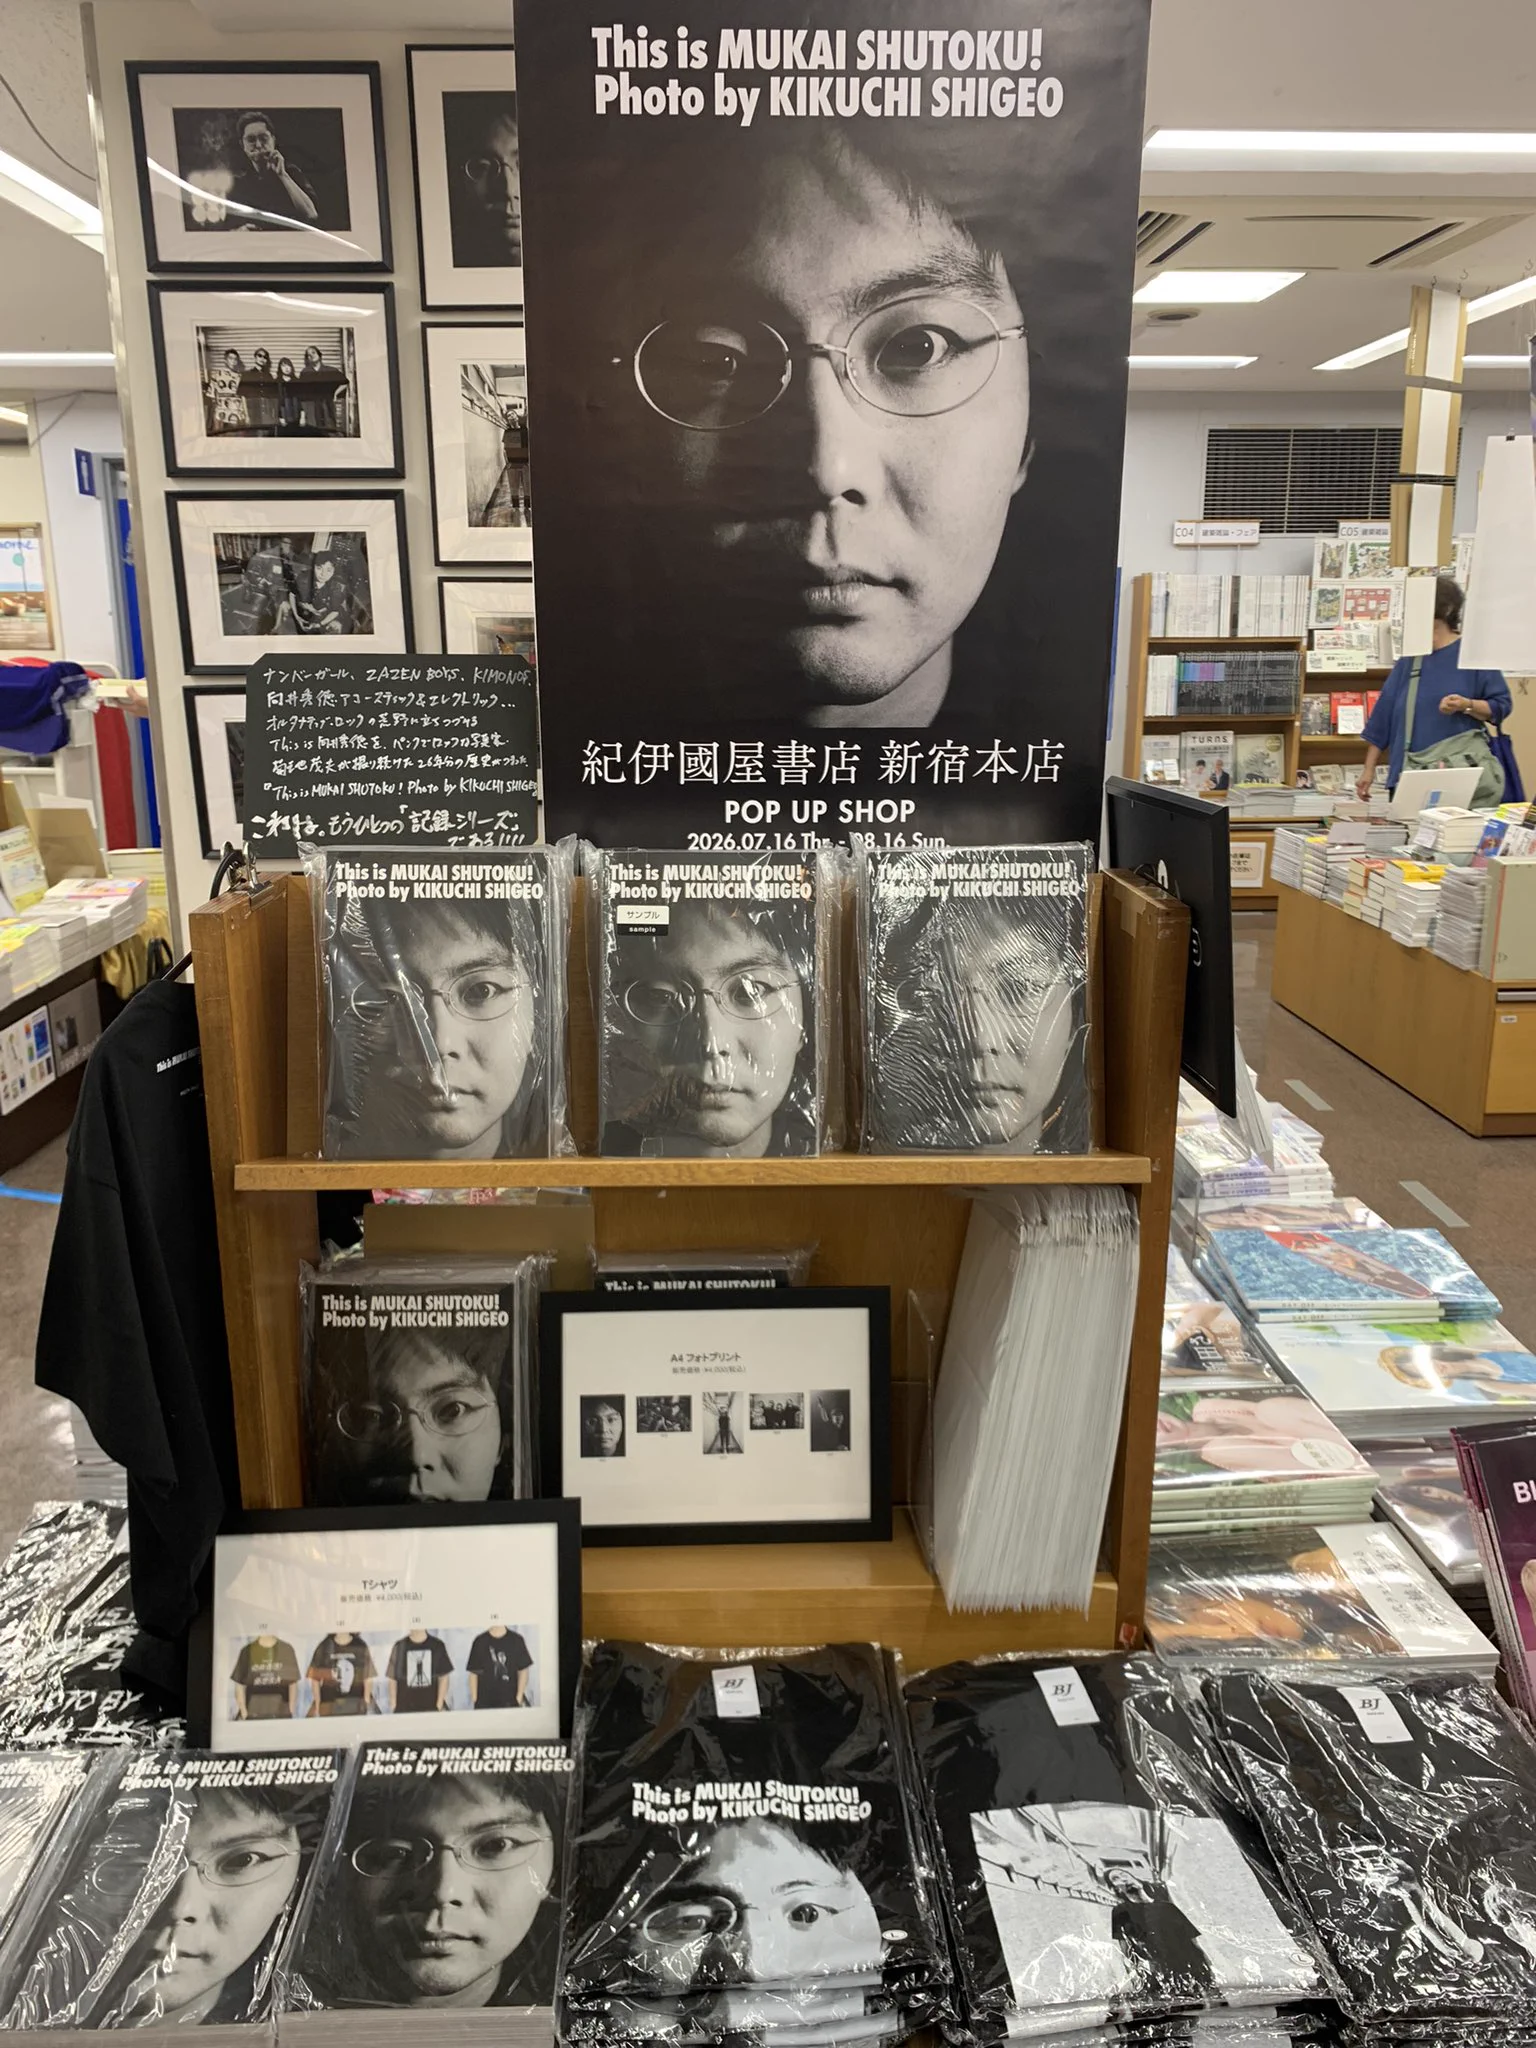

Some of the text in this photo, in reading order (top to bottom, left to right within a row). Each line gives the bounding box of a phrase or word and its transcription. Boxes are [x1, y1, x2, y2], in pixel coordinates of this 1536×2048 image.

[592, 25, 1042, 71] This is MUKAI SHUTOKU!
[595, 73, 1064, 127] Photo by KIKUCHI SHIGEO
[366, 666, 421, 682] ZAZEN
[269, 736, 300, 752] This
[303, 740, 314, 750] is
[581, 739, 1066, 786] 紀伊國屋書店 新宿本店
[299, 789, 310, 798] is
[311, 782, 345, 797] MUKAI
[407, 779, 440, 795] Photo
[443, 778, 457, 797] by
[459, 777, 504, 795] KIKUCHI
[724, 799, 916, 824] POP UP SHOP
[687, 832, 797, 850] 2026.07.16
[912, 832, 950, 850] Sun.
[336, 862, 533, 881] This is MUKAI SHUTOKU!
[610, 863, 802, 881] This is MUKAI SHUTOKU!
[932, 863, 985, 880] MUKAI
[988, 862, 1071, 880] SHUTOKU!
[336, 882, 544, 902] Photo by KIKUCHI SHIGEO
[611, 882, 812, 903] Photo by KIKUCHI SHIGEO
[930, 881, 949, 901] by
[953, 881, 1019, 898] KIKUCHI
[1023, 881, 1081, 898] SHIGEO
[626, 910, 660, 920] サンプル
[629, 925, 656, 934] sample
[322, 1294, 500, 1311] This is MUKAI SHUTOKU!
[322, 1311, 509, 1331] Photo by KIKUCHI SHIGEO
[671, 1351, 742, 1363] A4 フォトプリント
[361, 1579, 398, 1591] Tシャツ
[98, 1688, 145, 1713] BY
[366, 1746, 567, 1762] This is MUKAI SHUTOKU!
[127, 1756, 333, 1776] This is MUKAI SHUTOKU!
[361, 1759, 575, 1778] Photo by KIKUCHI SHIGEO
[175, 1775, 198, 1791] by
[200, 1772, 272, 1788] KIKUCHI
[275, 1769, 338, 1785] SHIGEO
[632, 1780, 859, 1806] This is MUKAI SHUTOKU!
[632, 1799, 872, 1824] Photo by KIKUCHI SHIGEO
